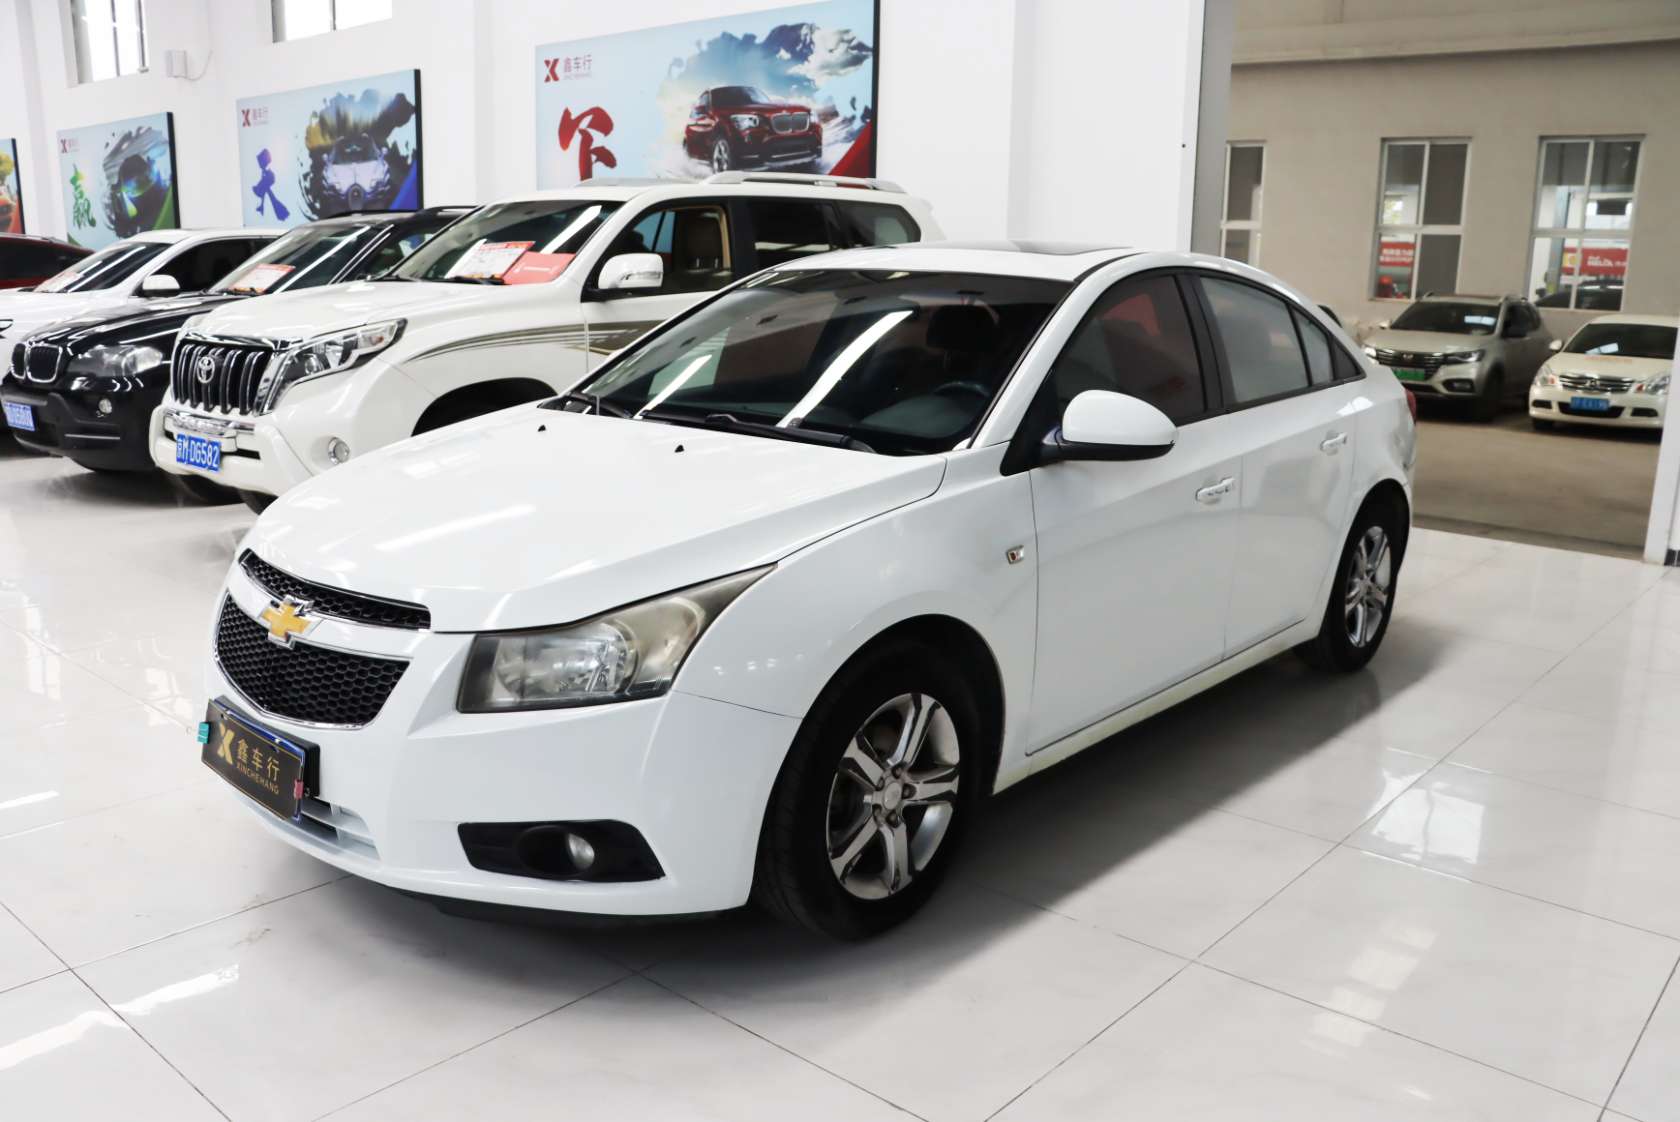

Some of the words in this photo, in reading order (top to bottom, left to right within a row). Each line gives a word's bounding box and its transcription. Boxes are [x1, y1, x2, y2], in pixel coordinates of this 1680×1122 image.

[563, 54, 593, 73] 鑫车行
[237, 738, 280, 782] 鑫车行
